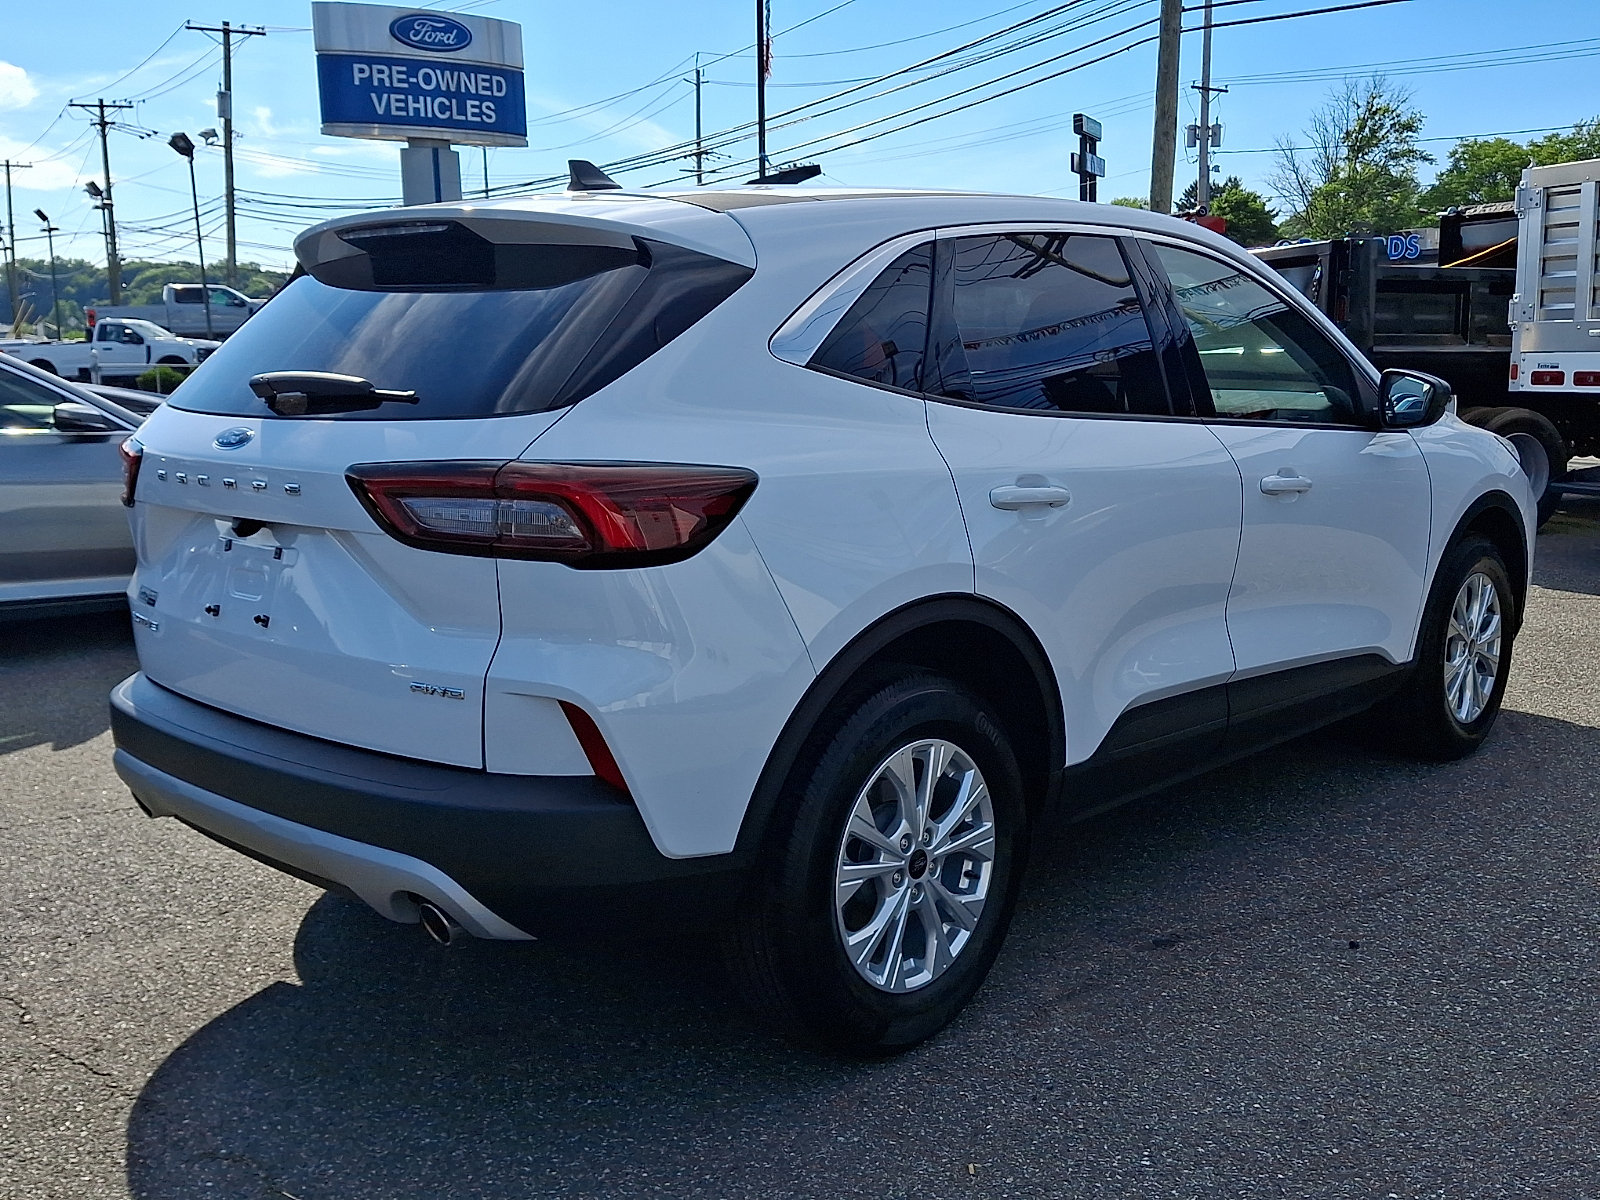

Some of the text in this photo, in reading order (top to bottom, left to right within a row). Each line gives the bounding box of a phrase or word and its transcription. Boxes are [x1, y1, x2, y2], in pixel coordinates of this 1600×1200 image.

[409, 19, 457, 45] Ford
[352, 63, 507, 97] PRE-OWNED
[370, 92, 496, 124] VEHICLES
[1373, 233, 1421, 260] DS
